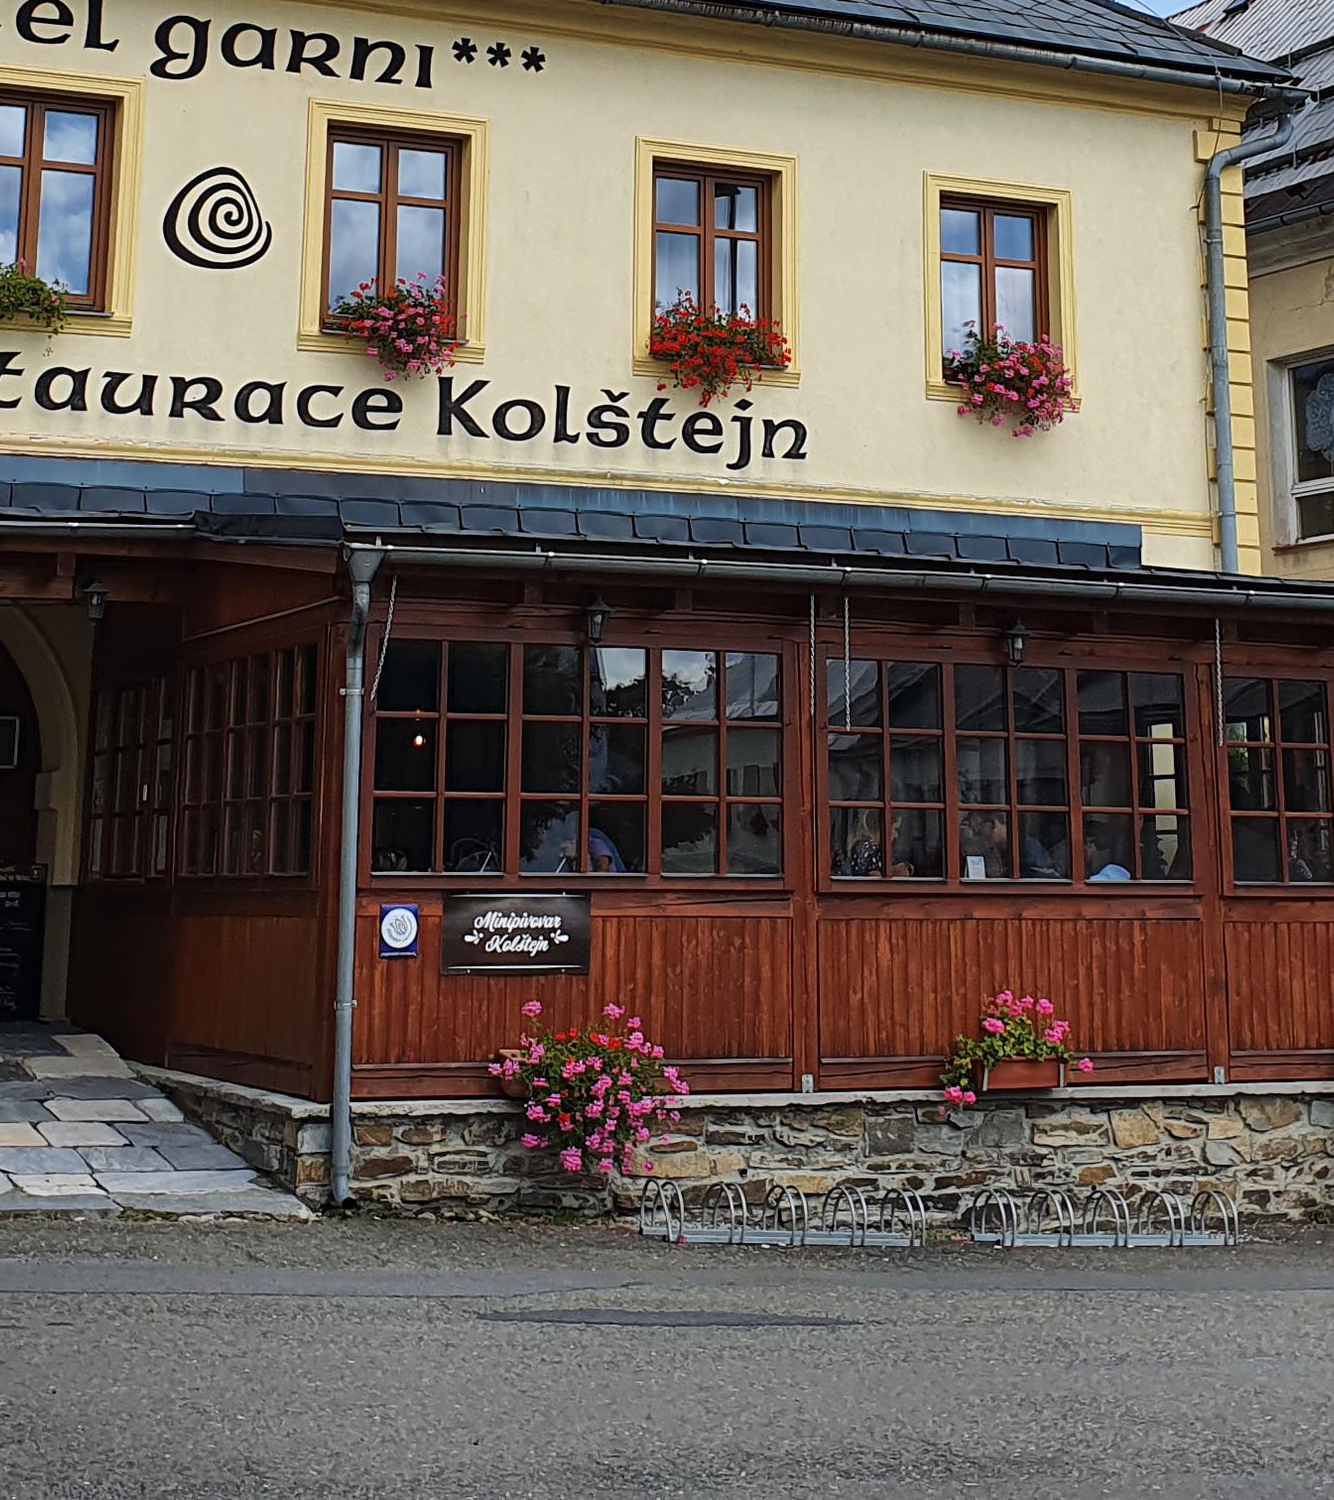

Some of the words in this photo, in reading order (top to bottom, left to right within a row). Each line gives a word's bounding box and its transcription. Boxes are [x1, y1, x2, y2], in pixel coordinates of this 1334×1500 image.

[436, 375, 809, 471] Kolštejn
[474, 911, 562, 933] Minipivovar
[485, 933, 550, 957] Kolštejn
